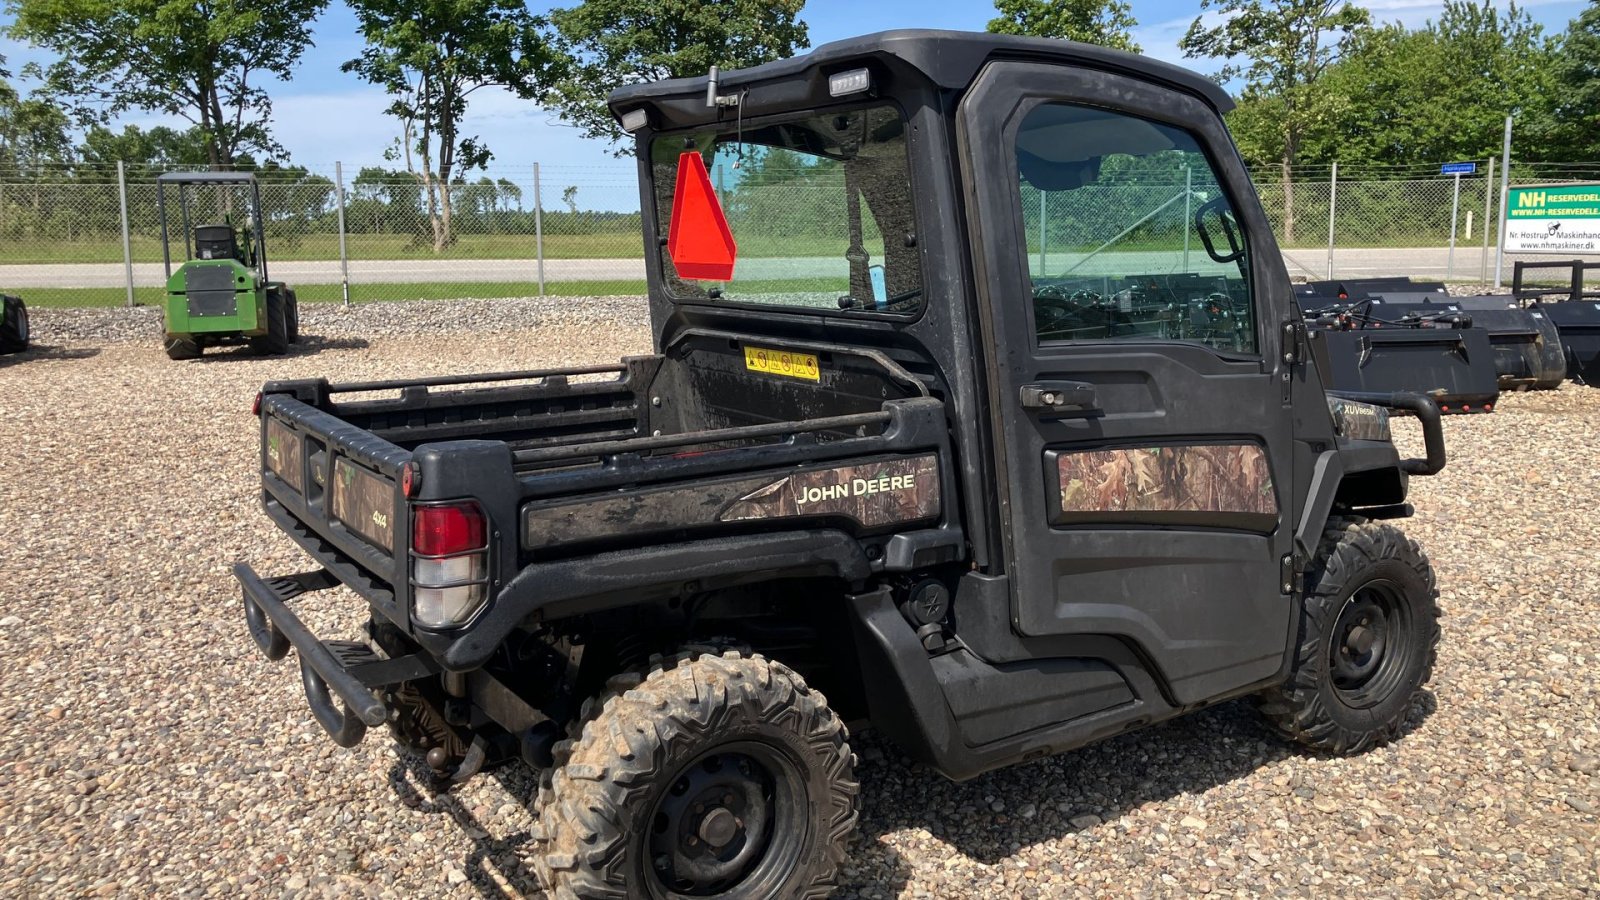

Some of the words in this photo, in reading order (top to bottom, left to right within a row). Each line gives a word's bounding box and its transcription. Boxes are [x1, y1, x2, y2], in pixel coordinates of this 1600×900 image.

[1518, 191, 1546, 207] NH
[1509, 231, 1519, 239] Nr.
[1520, 232, 1549, 240] Hostrup
[1520, 241, 1595, 250] www.nhmaskiner.dk
[797, 484, 849, 504] JOHN
[852, 474, 915, 496] DEERE
